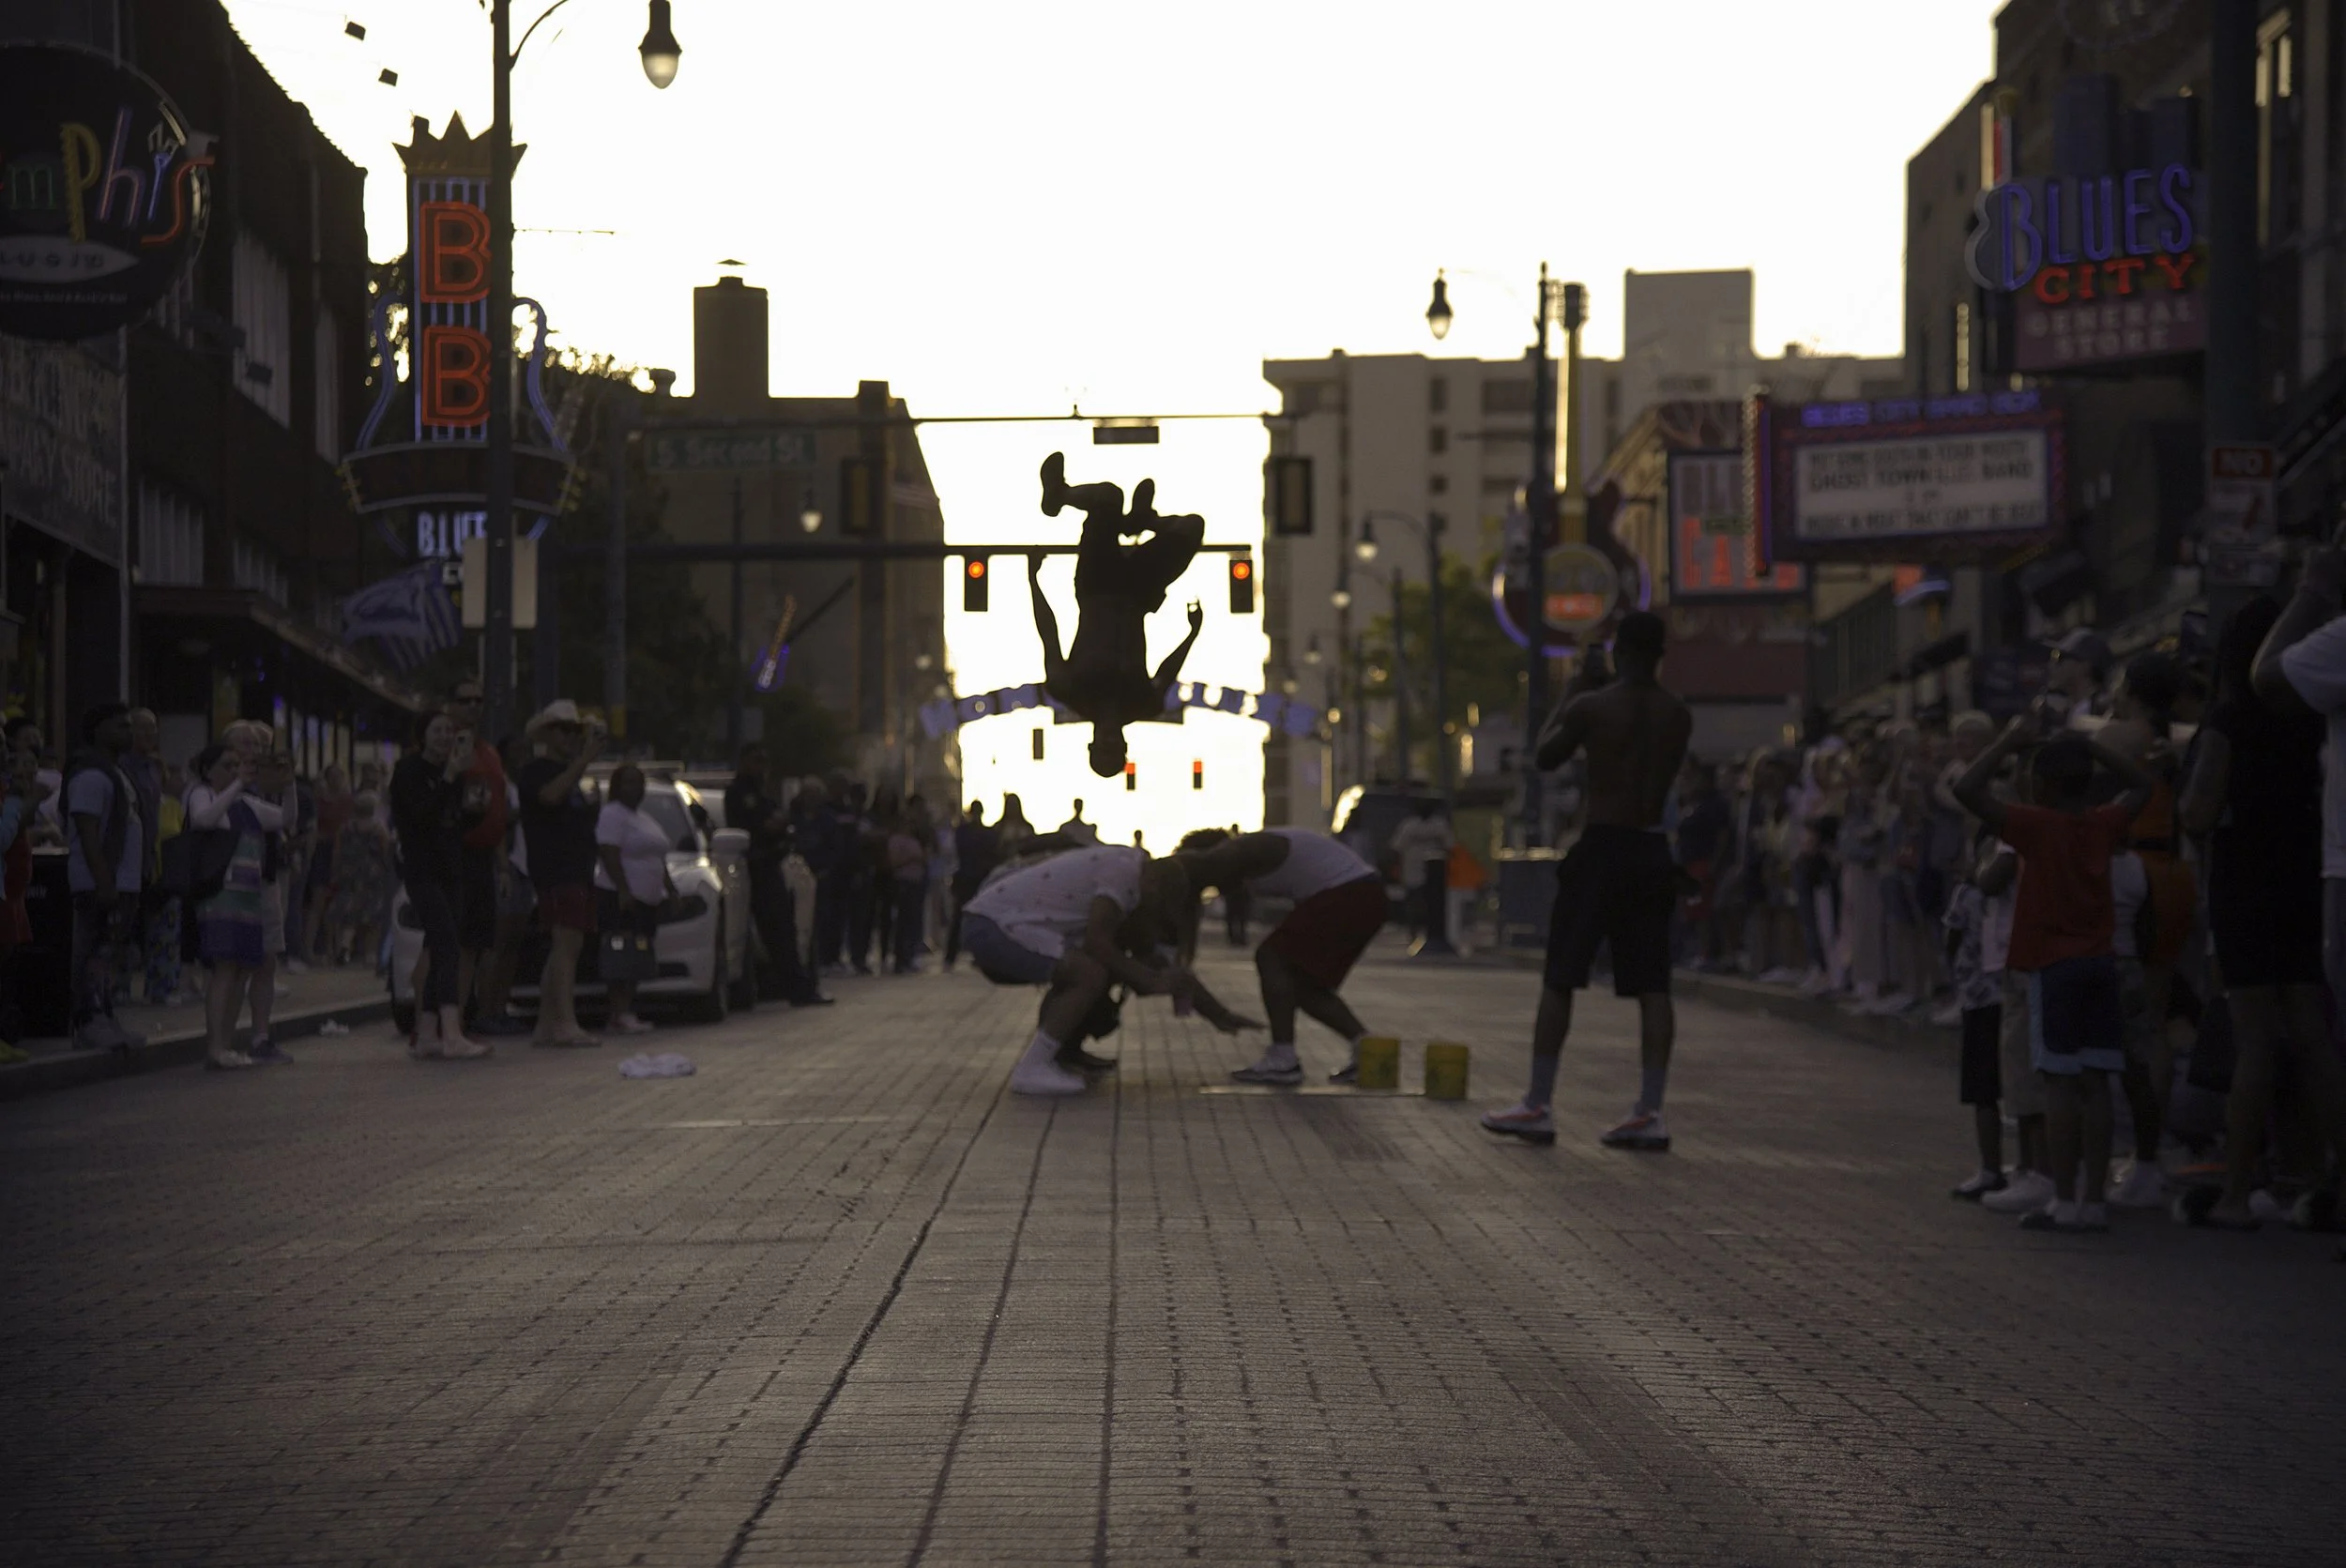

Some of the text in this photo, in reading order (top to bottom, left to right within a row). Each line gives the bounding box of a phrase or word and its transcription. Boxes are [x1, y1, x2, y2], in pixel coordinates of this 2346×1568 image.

[2002, 162, 2192, 292] BLUES
[419, 201, 492, 303] B
[2034, 253, 2195, 304] CITY
[2024, 297, 2195, 337] GENERAL
[2054, 327, 2169, 358] STORE
[421, 325, 492, 426] B
[685, 436, 770, 466] Second
[2220, 449, 2264, 476] NO
[419, 511, 488, 557] BLUE
